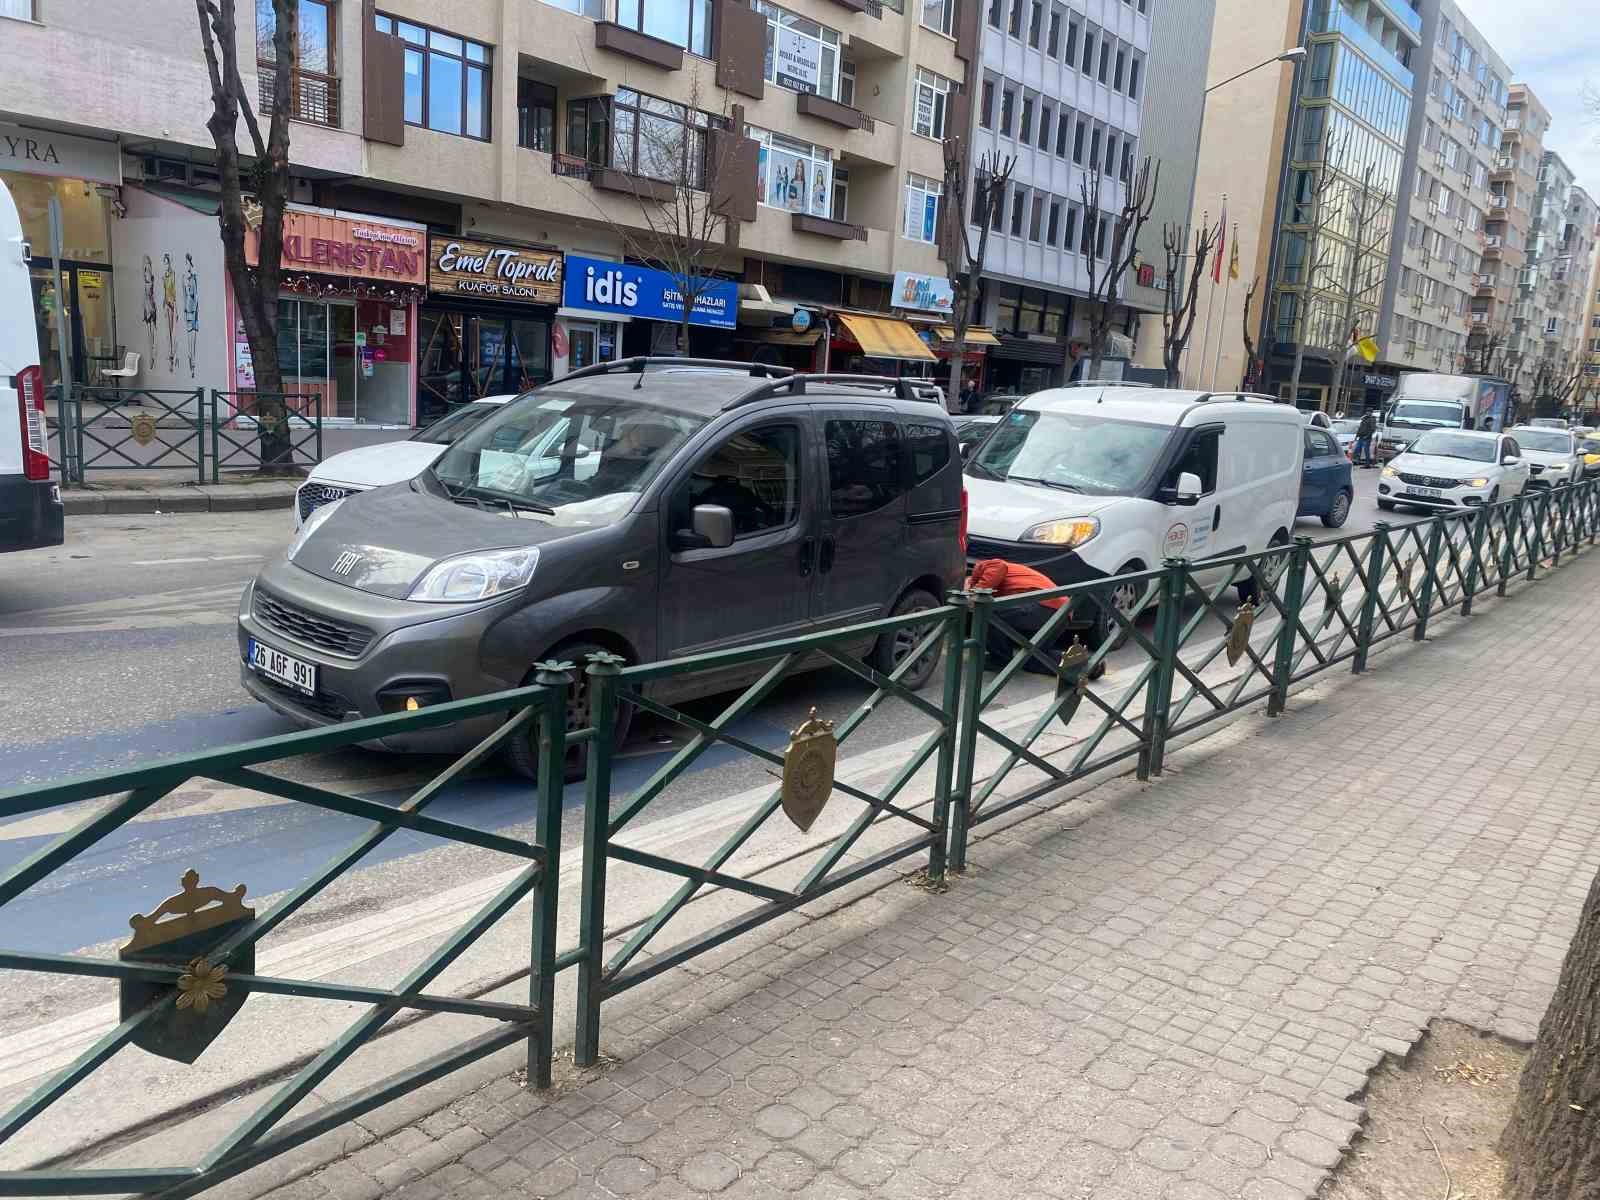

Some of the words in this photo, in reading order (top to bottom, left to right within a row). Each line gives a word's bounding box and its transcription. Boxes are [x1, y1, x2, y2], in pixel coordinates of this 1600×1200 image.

[440, 243, 494, 272] Emel
[495, 249, 558, 283] Toprak
[502, 285, 539, 297] SALONU
[586, 266, 638, 307] idis
[331, 551, 362, 576] FIAT
[255, 644, 265, 667] 26
[270, 655, 289, 677] AGF
[295, 662, 313, 688] 991
